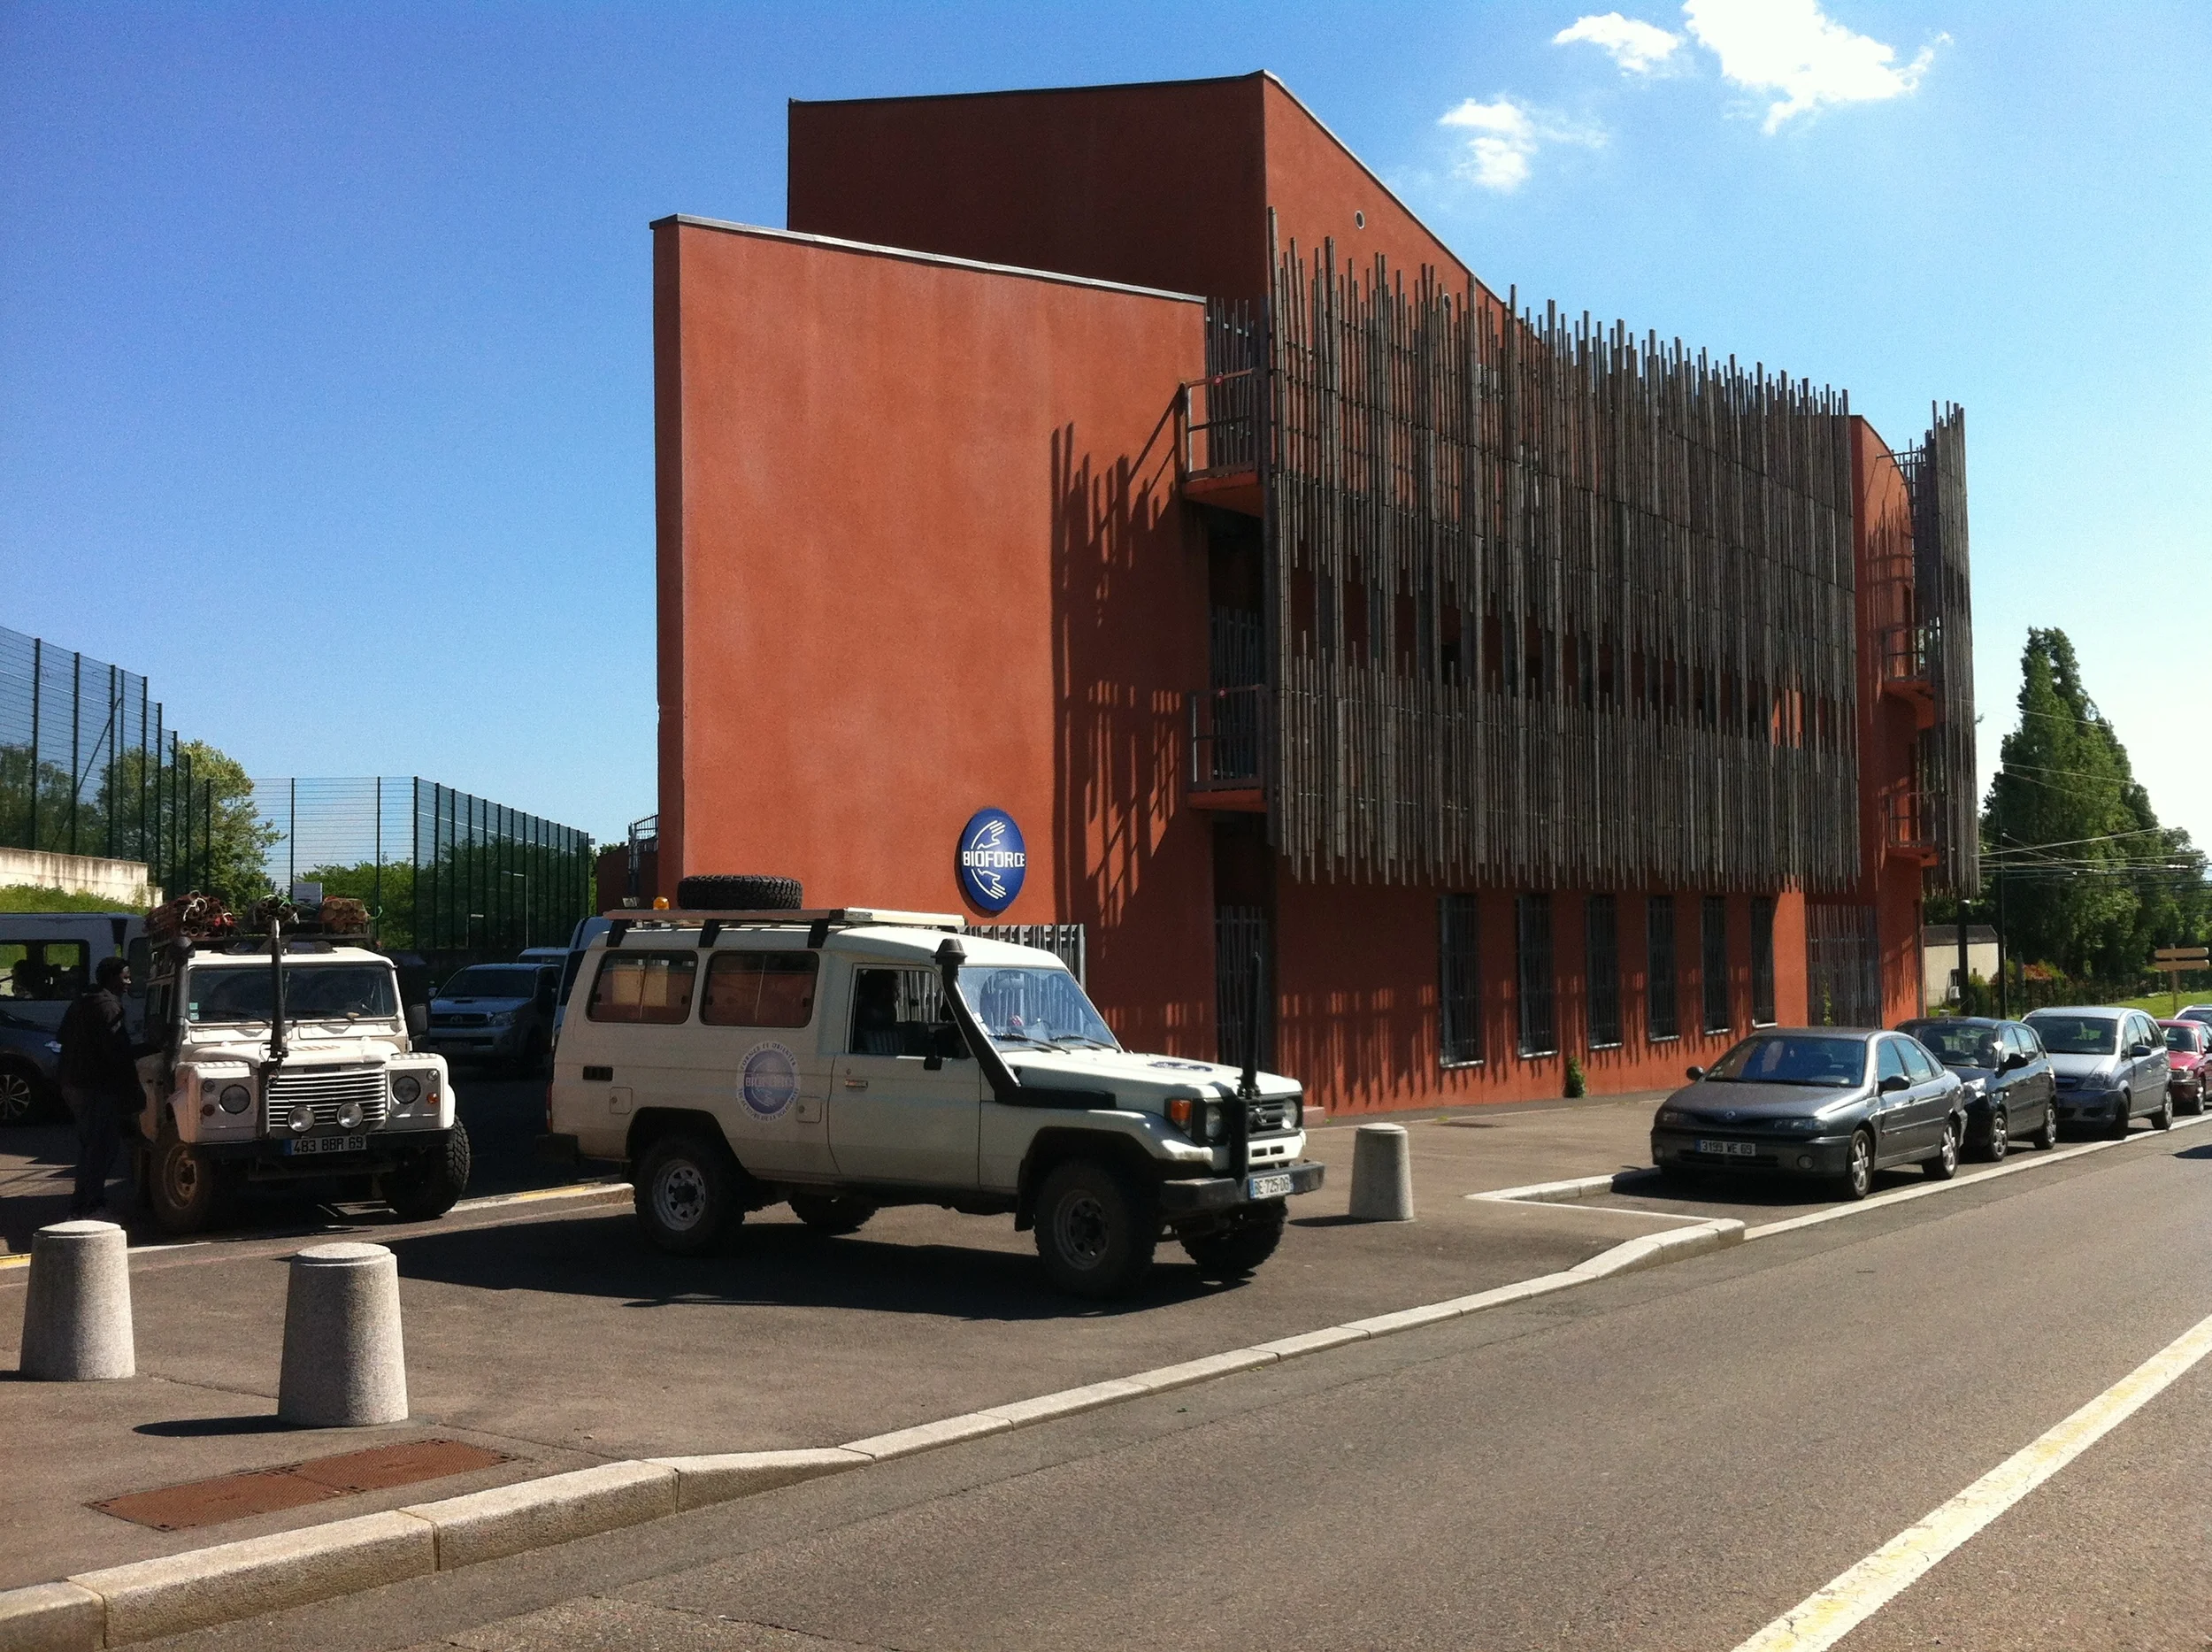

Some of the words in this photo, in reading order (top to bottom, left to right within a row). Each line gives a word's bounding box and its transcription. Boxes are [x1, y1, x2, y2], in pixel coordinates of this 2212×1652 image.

[963, 850, 1025, 867] BIOFORCE
[294, 1140, 317, 1153] 483
[321, 1138, 344, 1151] BBR
[348, 1136, 364, 1149] 69
